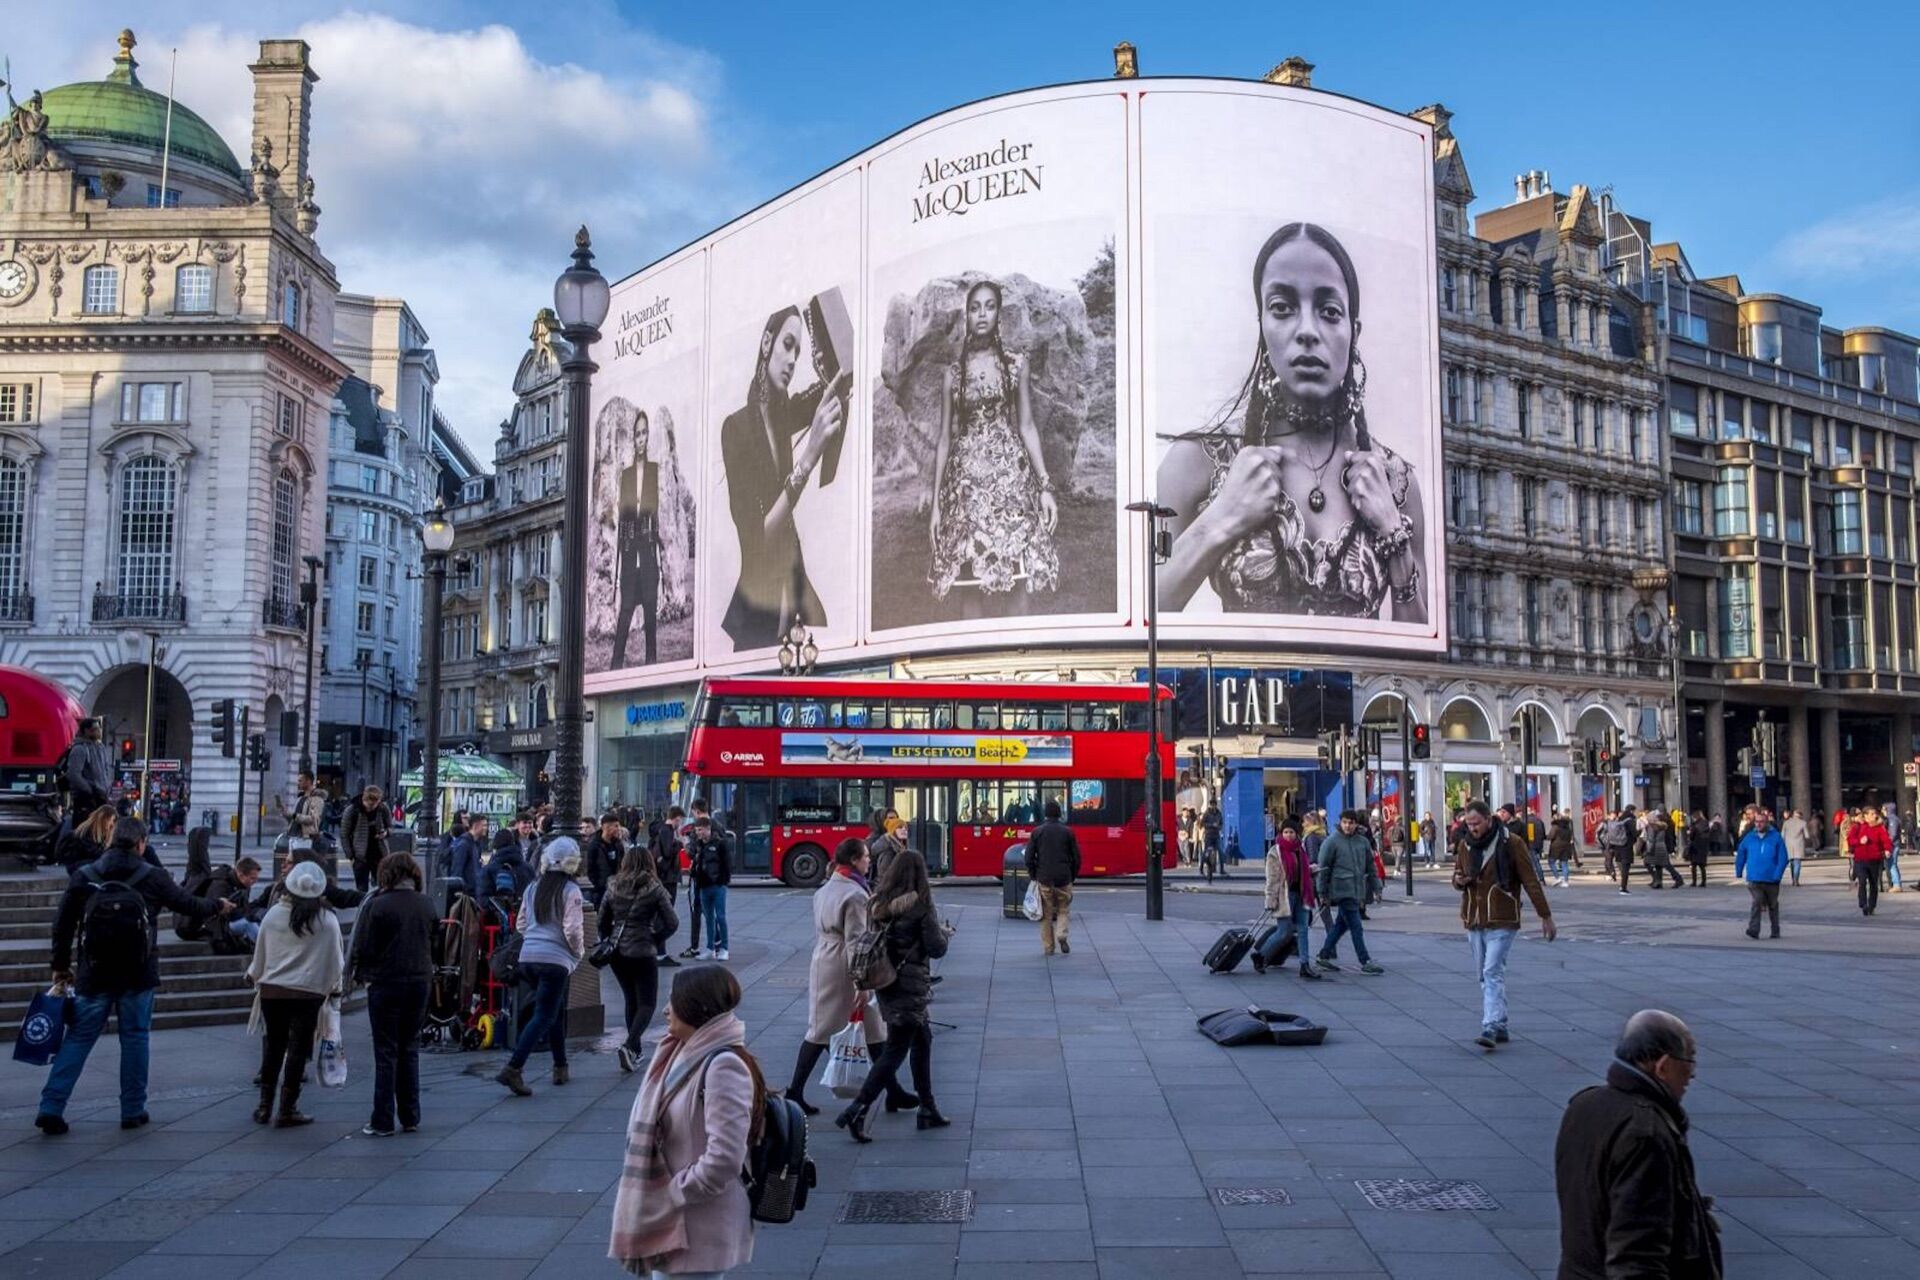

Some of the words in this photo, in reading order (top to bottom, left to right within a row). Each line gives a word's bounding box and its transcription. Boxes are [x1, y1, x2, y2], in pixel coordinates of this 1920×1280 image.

[918, 138, 1033, 189] Alexander
[912, 165, 1045, 223] McQUEEN
[618, 295, 670, 334] Alexander
[614, 314, 673, 360] McQUEEN
[636, 701, 685, 722] BARCLAYS
[1222, 677, 1284, 725] GAP
[733, 753, 765, 761] ARRIVA
[892, 746, 921, 757] LET'S
[922, 746, 944, 757] GET
[946, 747, 972, 758] YOU
[979, 746, 1012, 758] Beach
[837, 1045, 867, 1059] TESC
